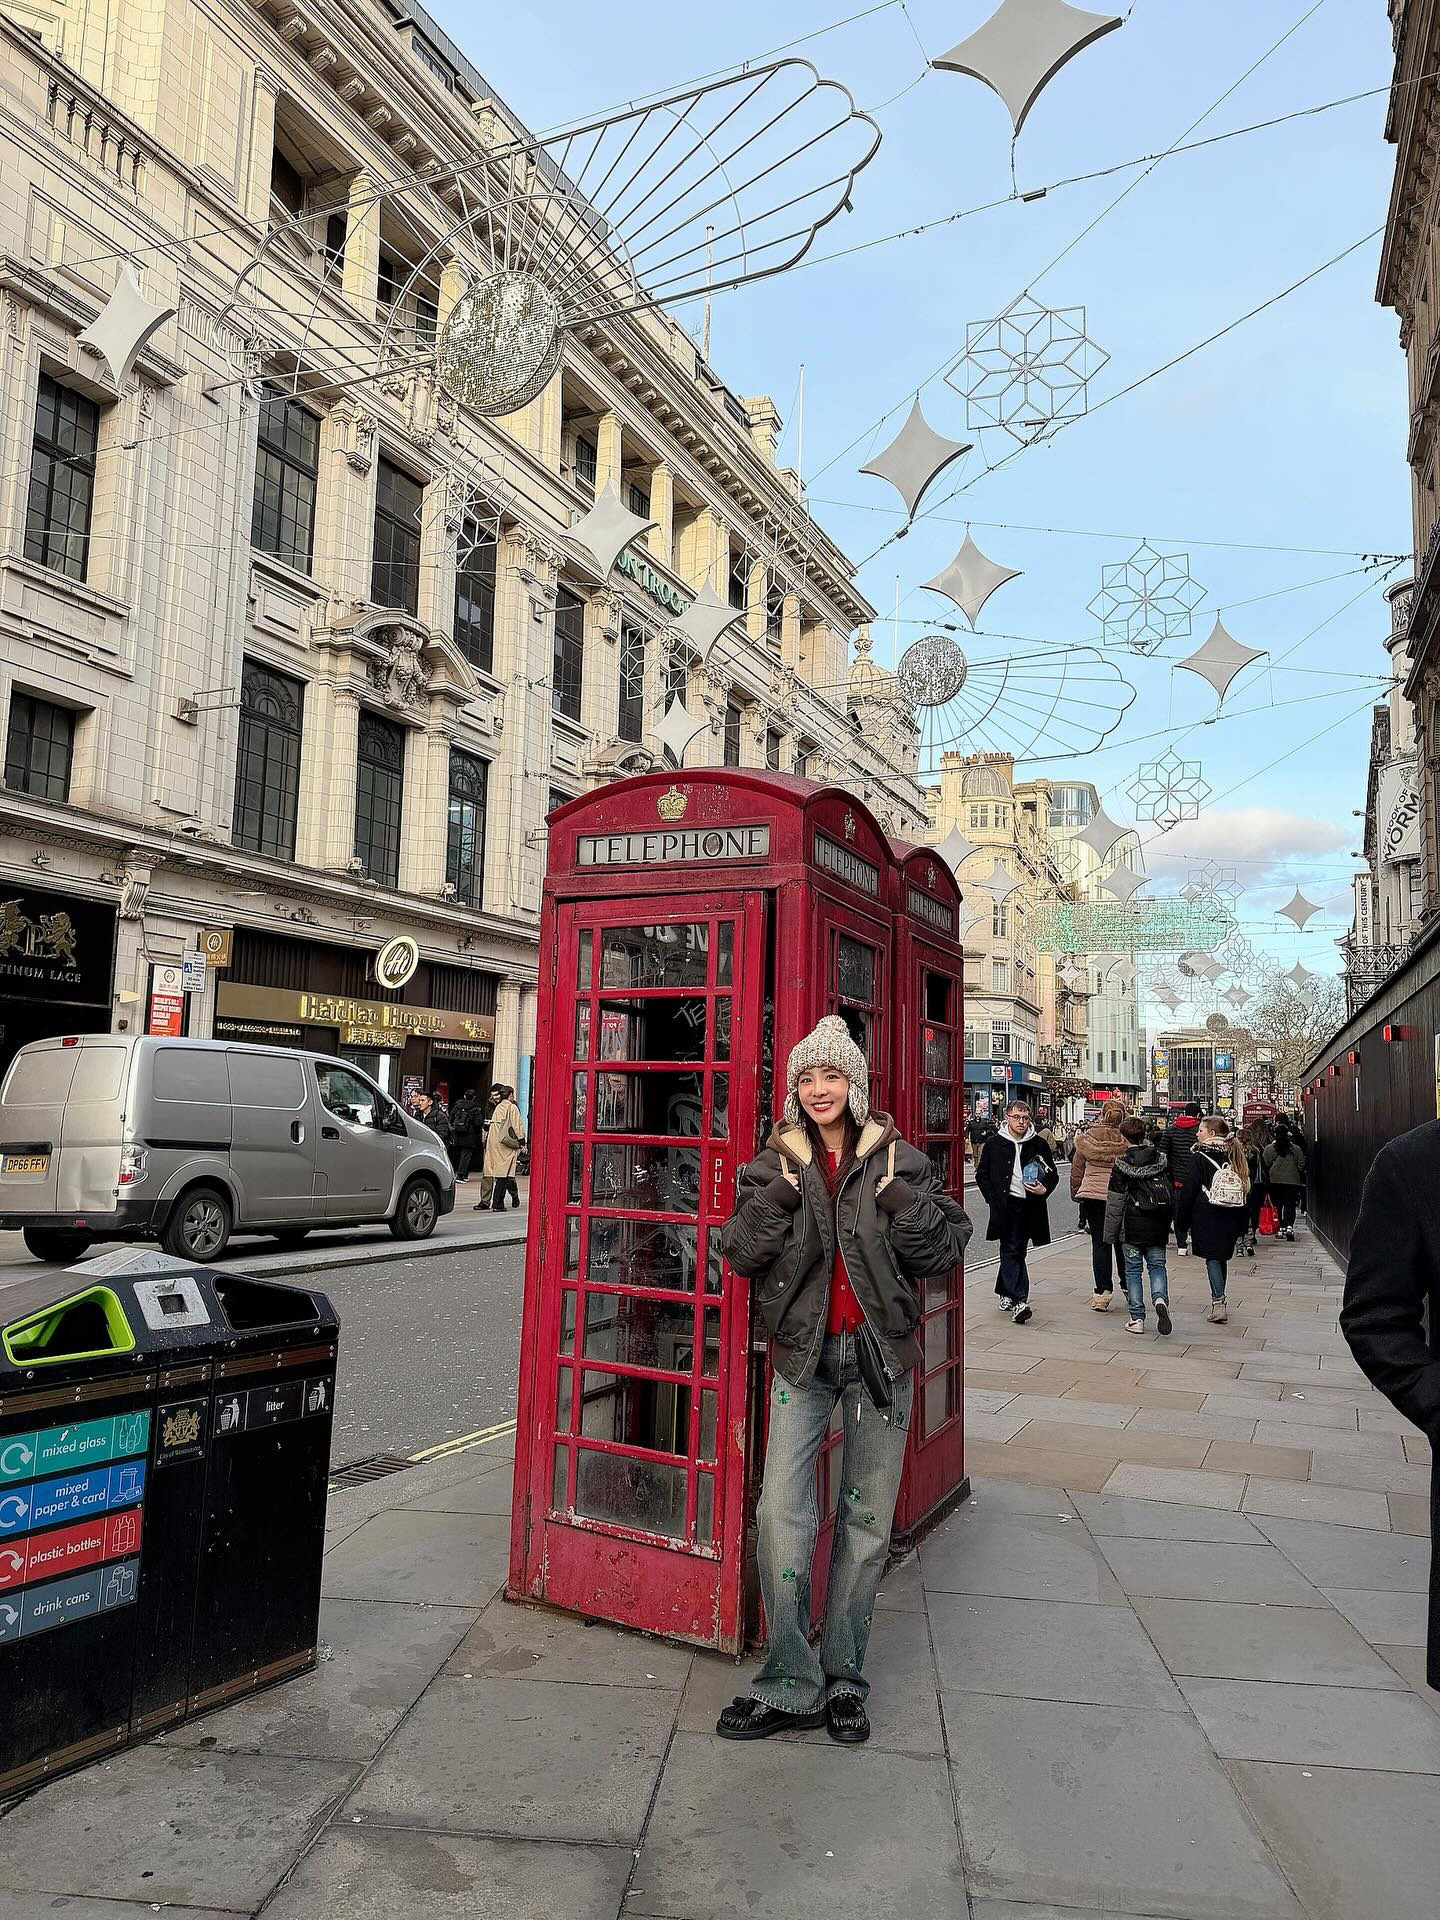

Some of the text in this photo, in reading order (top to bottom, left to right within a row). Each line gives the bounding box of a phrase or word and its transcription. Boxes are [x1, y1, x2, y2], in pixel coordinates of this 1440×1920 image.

[1387, 804, 1402, 835] BOOK
[1399, 788, 1409, 804] OF
[586, 829, 764, 863] TELEPHONE
[815, 836, 878, 895] TELEPHONE
[908, 887, 953, 932] TELEPHONE
[1361, 916, 1369, 932] THIS
[1361, 934, 1369, 945] OF
[49, 969, 81, 983] LACE
[300, 994, 379, 1025] Haidilao
[8, 1158, 47, 1171] DP66 FFV
[713, 1158, 723, 1209] PULL
[265, 1401, 285, 1412] litter
[42, 1436, 106, 1458] mixed glass
[55, 1478, 89, 1498] mixed
[34, 1488, 106, 1520] paper & card
[29, 1537, 101, 1568] plastic bottles
[33, 1591, 90, 1616] drink cans
